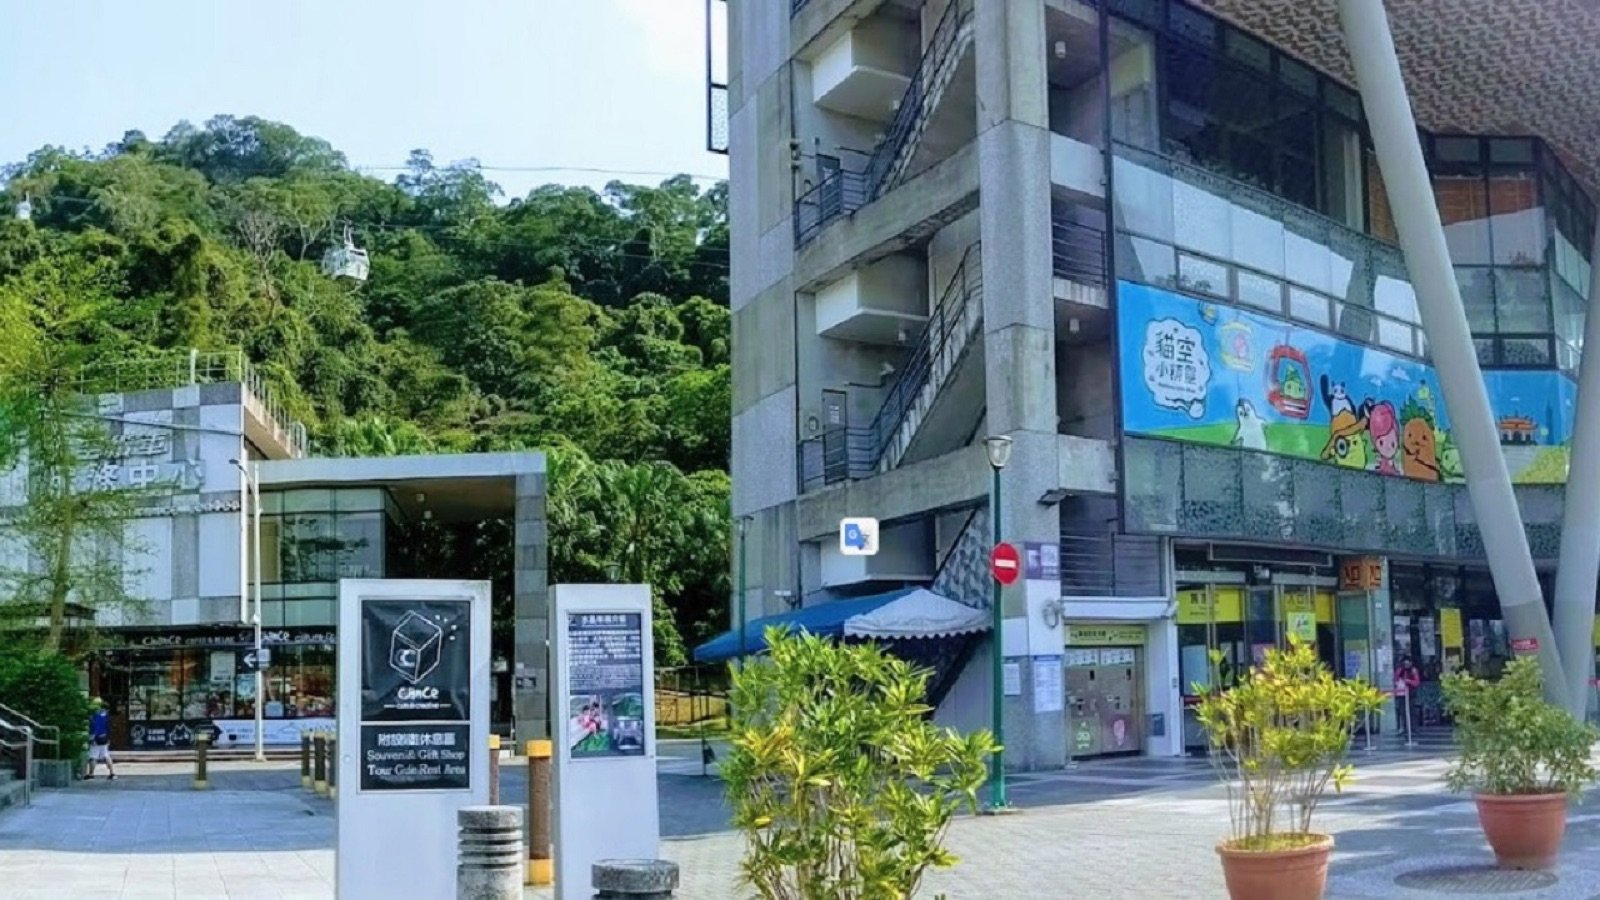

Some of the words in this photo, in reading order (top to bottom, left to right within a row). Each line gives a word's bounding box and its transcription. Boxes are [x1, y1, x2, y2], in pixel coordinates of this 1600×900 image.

[1155, 330, 1195, 364] 貓空
[417, 749, 439, 760] Gift
[440, 749, 466, 762] Shop
[367, 764, 392, 776] Tour
[419, 763, 441, 775] Rest
[444, 763, 467, 775] Area
